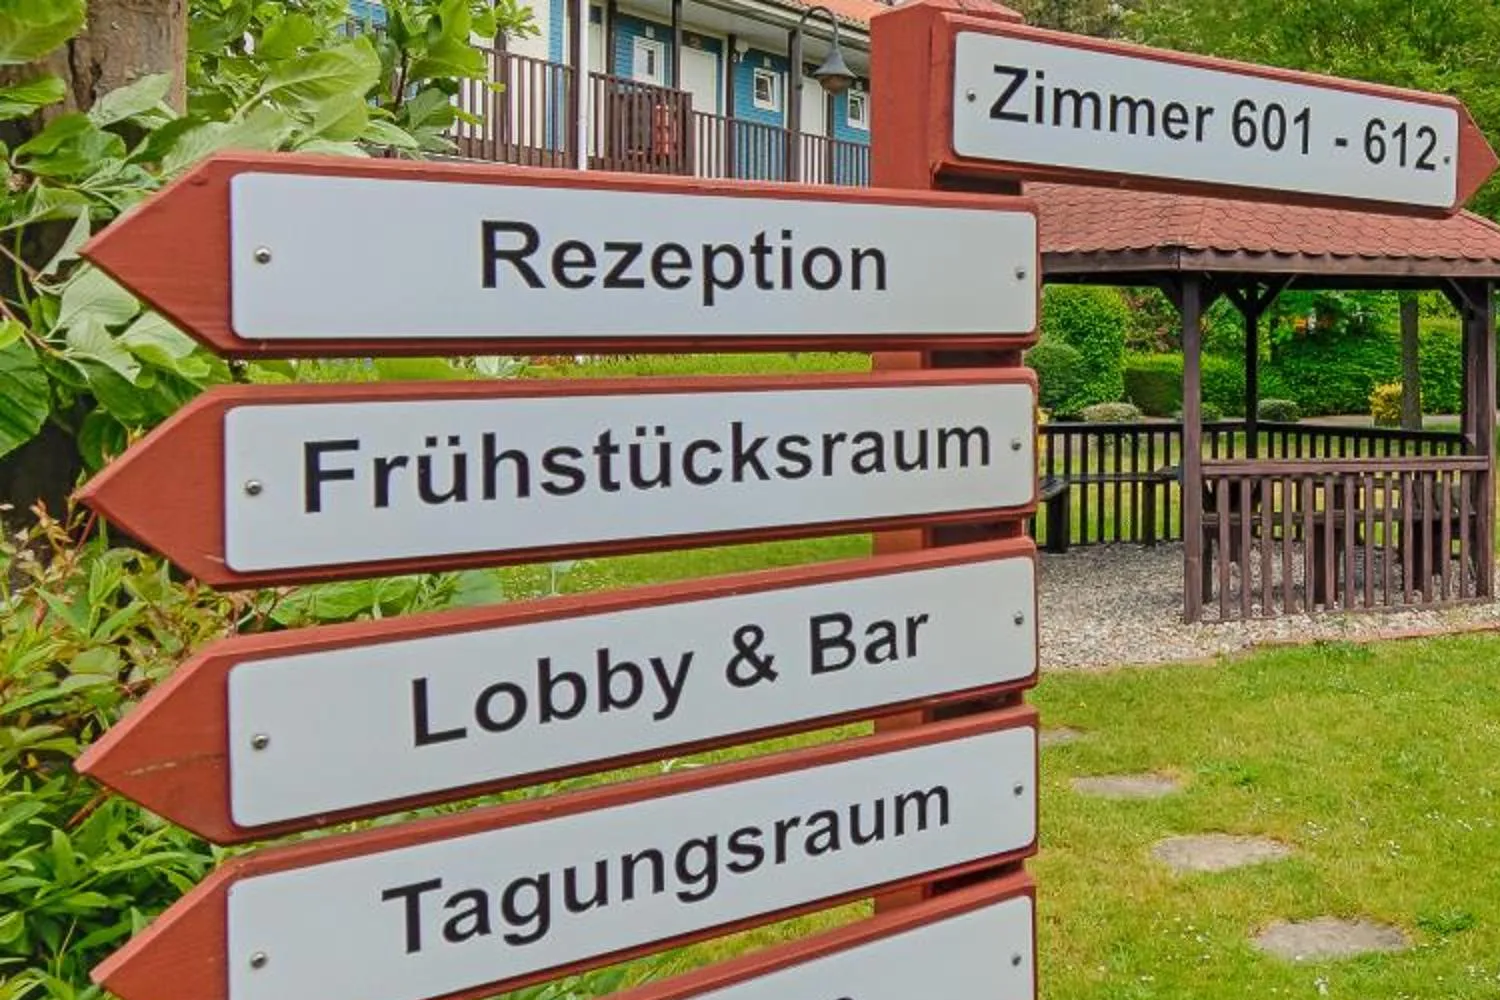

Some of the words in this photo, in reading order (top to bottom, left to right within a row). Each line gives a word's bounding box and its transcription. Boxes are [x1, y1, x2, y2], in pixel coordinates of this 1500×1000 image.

[989, 64, 1215, 144] Zimmer
[1231, 98, 1311, 156] 601
[1335, 137, 1349, 149] -
[1364, 117, 1438, 172] 612
[481, 219, 887, 307] Rezeption
[303, 422, 990, 514] Frühstücksraum
[412, 647, 695, 747] Lobby
[725, 622, 779, 690] &
[808, 611, 929, 676] Bar
[381, 785, 949, 955] Tagungsraum
